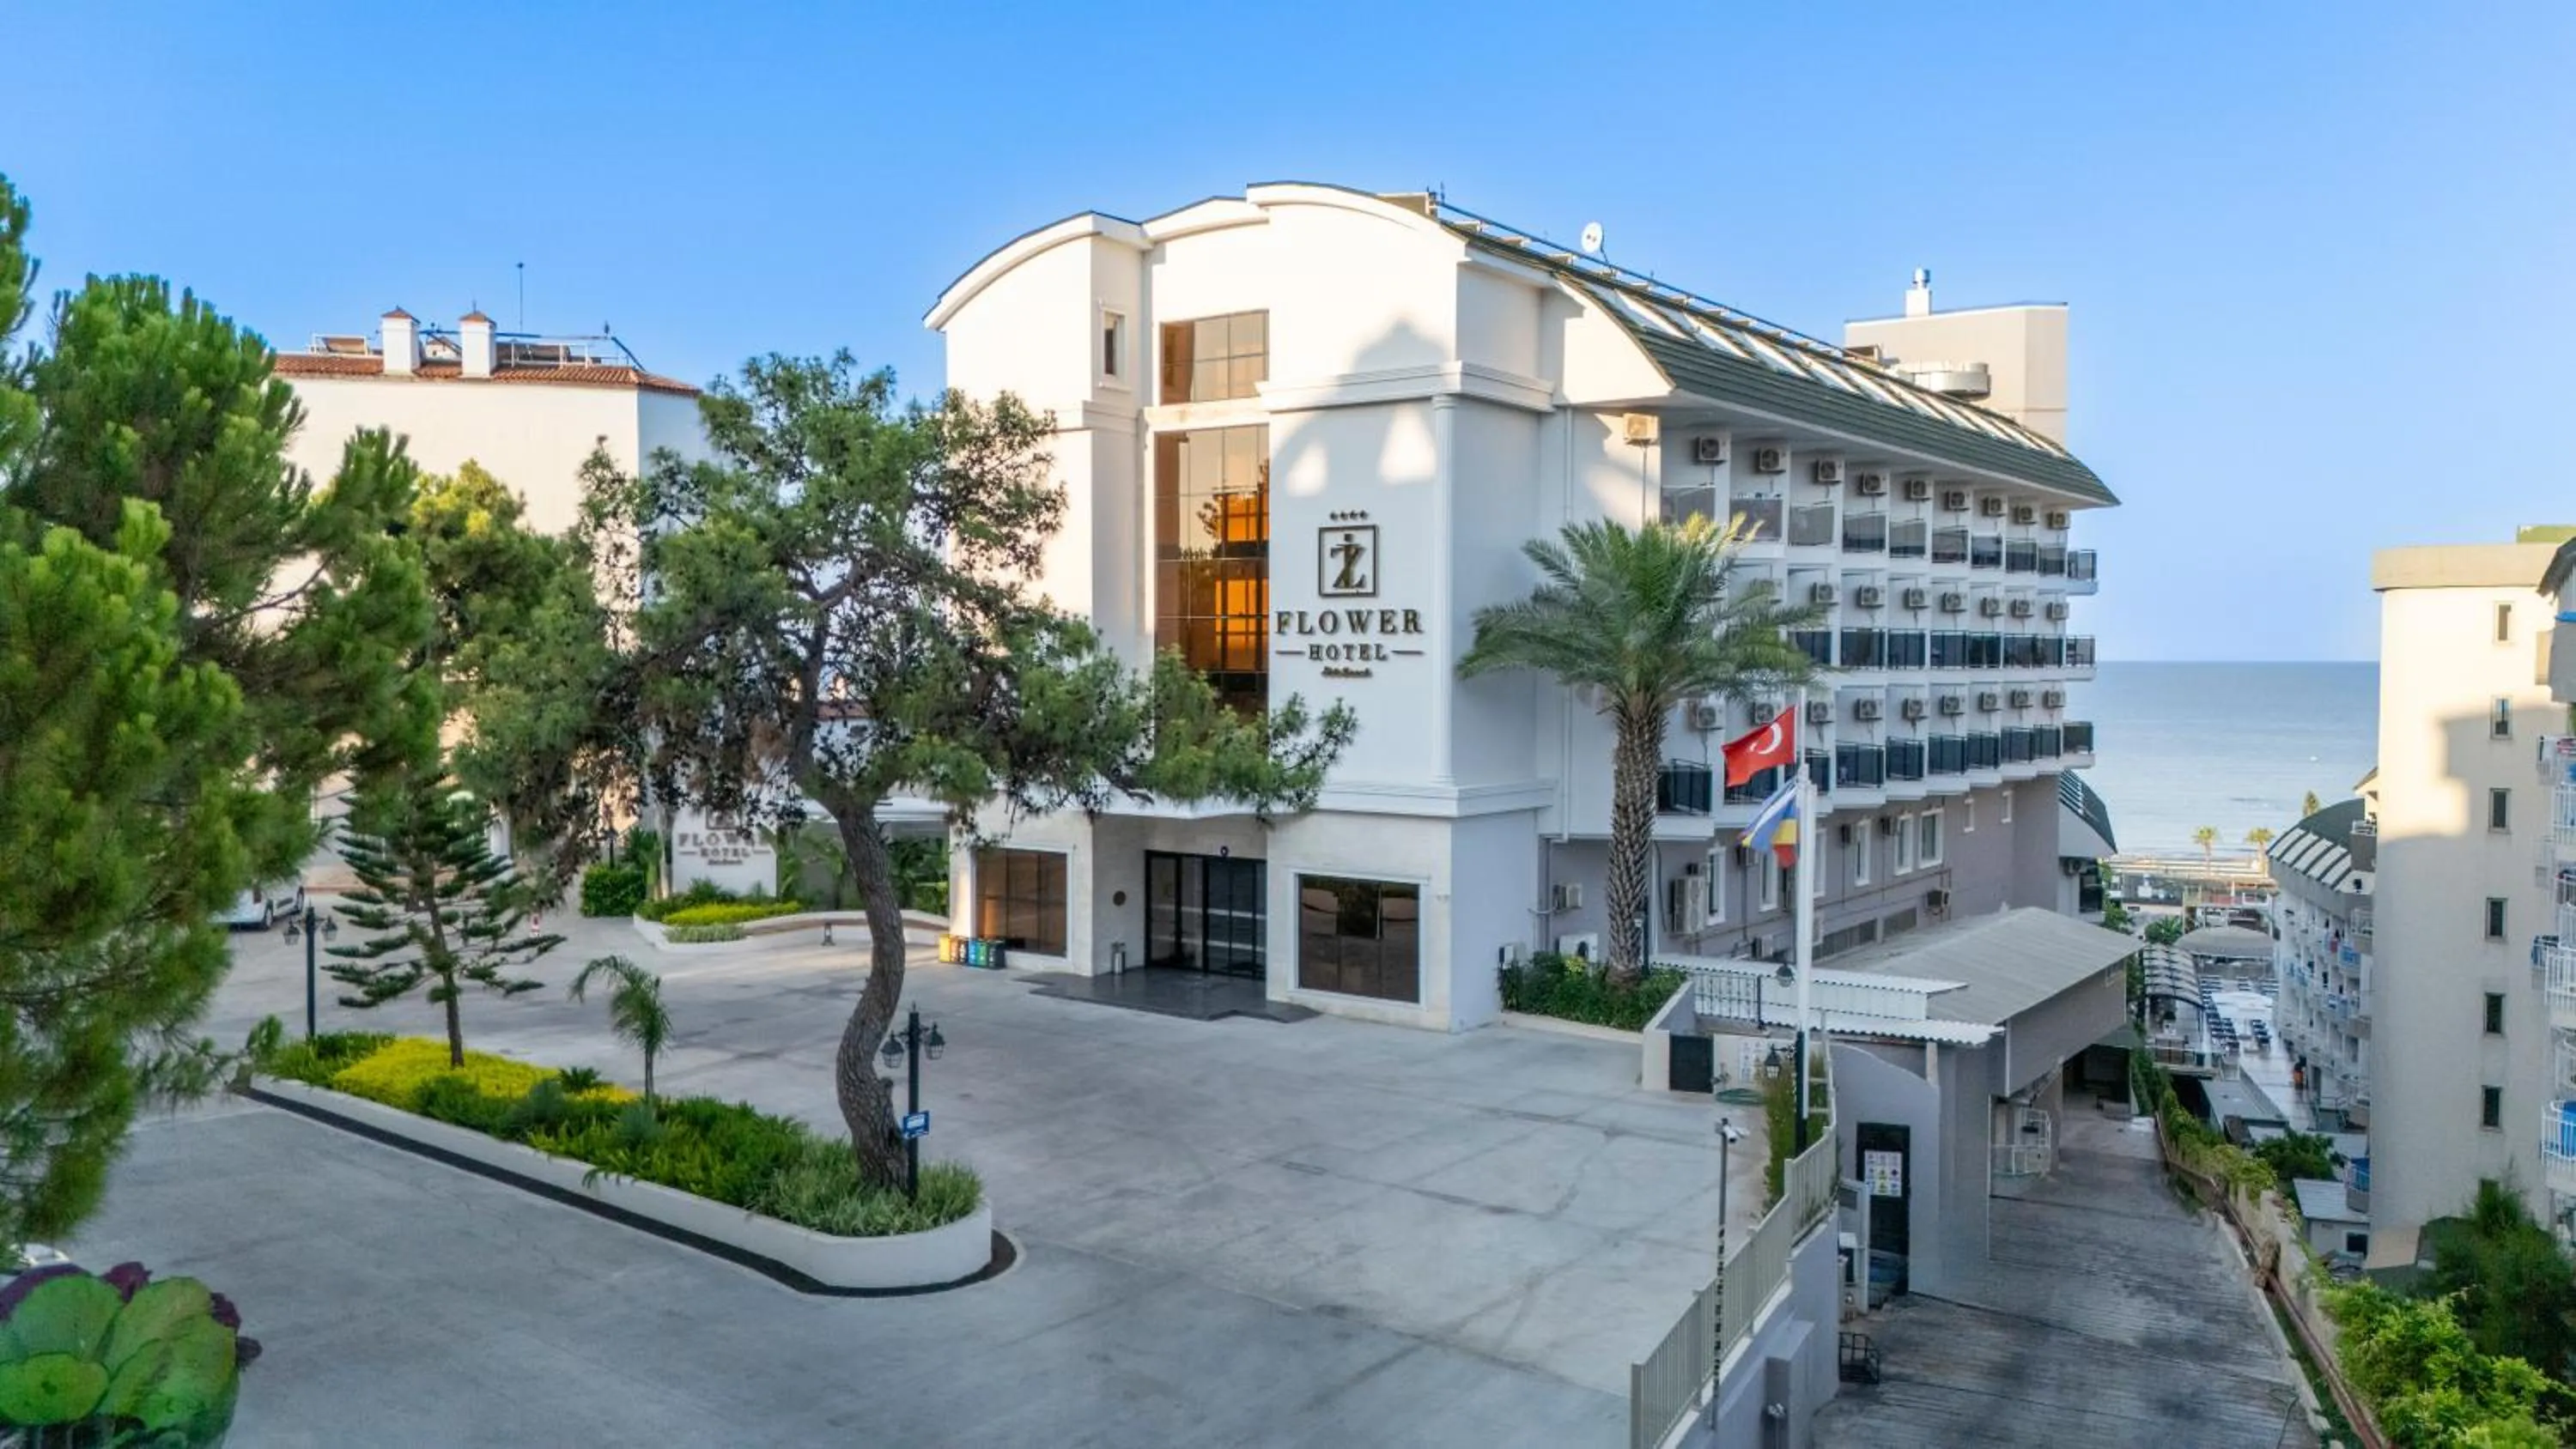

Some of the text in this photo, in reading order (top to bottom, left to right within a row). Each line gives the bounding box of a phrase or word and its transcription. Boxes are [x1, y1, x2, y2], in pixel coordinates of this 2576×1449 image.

[1276, 609, 1423, 635] FLOWER
[1308, 644, 1388, 660] HOTEL
[678, 832, 767, 846] FLOW
